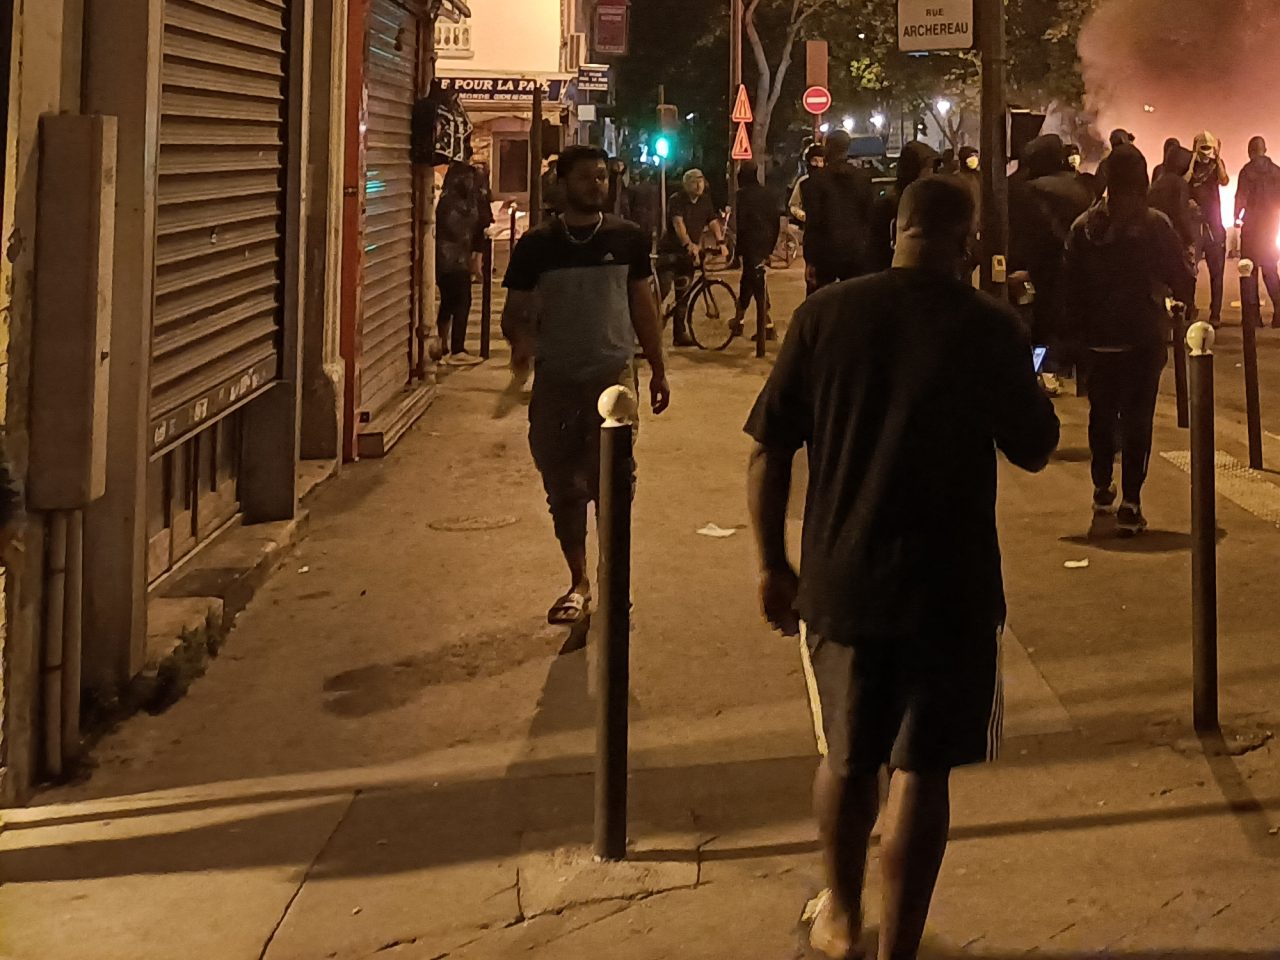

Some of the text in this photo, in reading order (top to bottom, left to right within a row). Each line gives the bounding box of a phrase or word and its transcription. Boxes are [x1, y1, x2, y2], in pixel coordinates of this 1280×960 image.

[926, 9, 944, 17] RUE
[903, 22, 969, 37] ARCHEREAU
[454, 79, 493, 90] POUR
[497, 79, 517, 91] LA
[518, 79, 552, 92] PAIX
